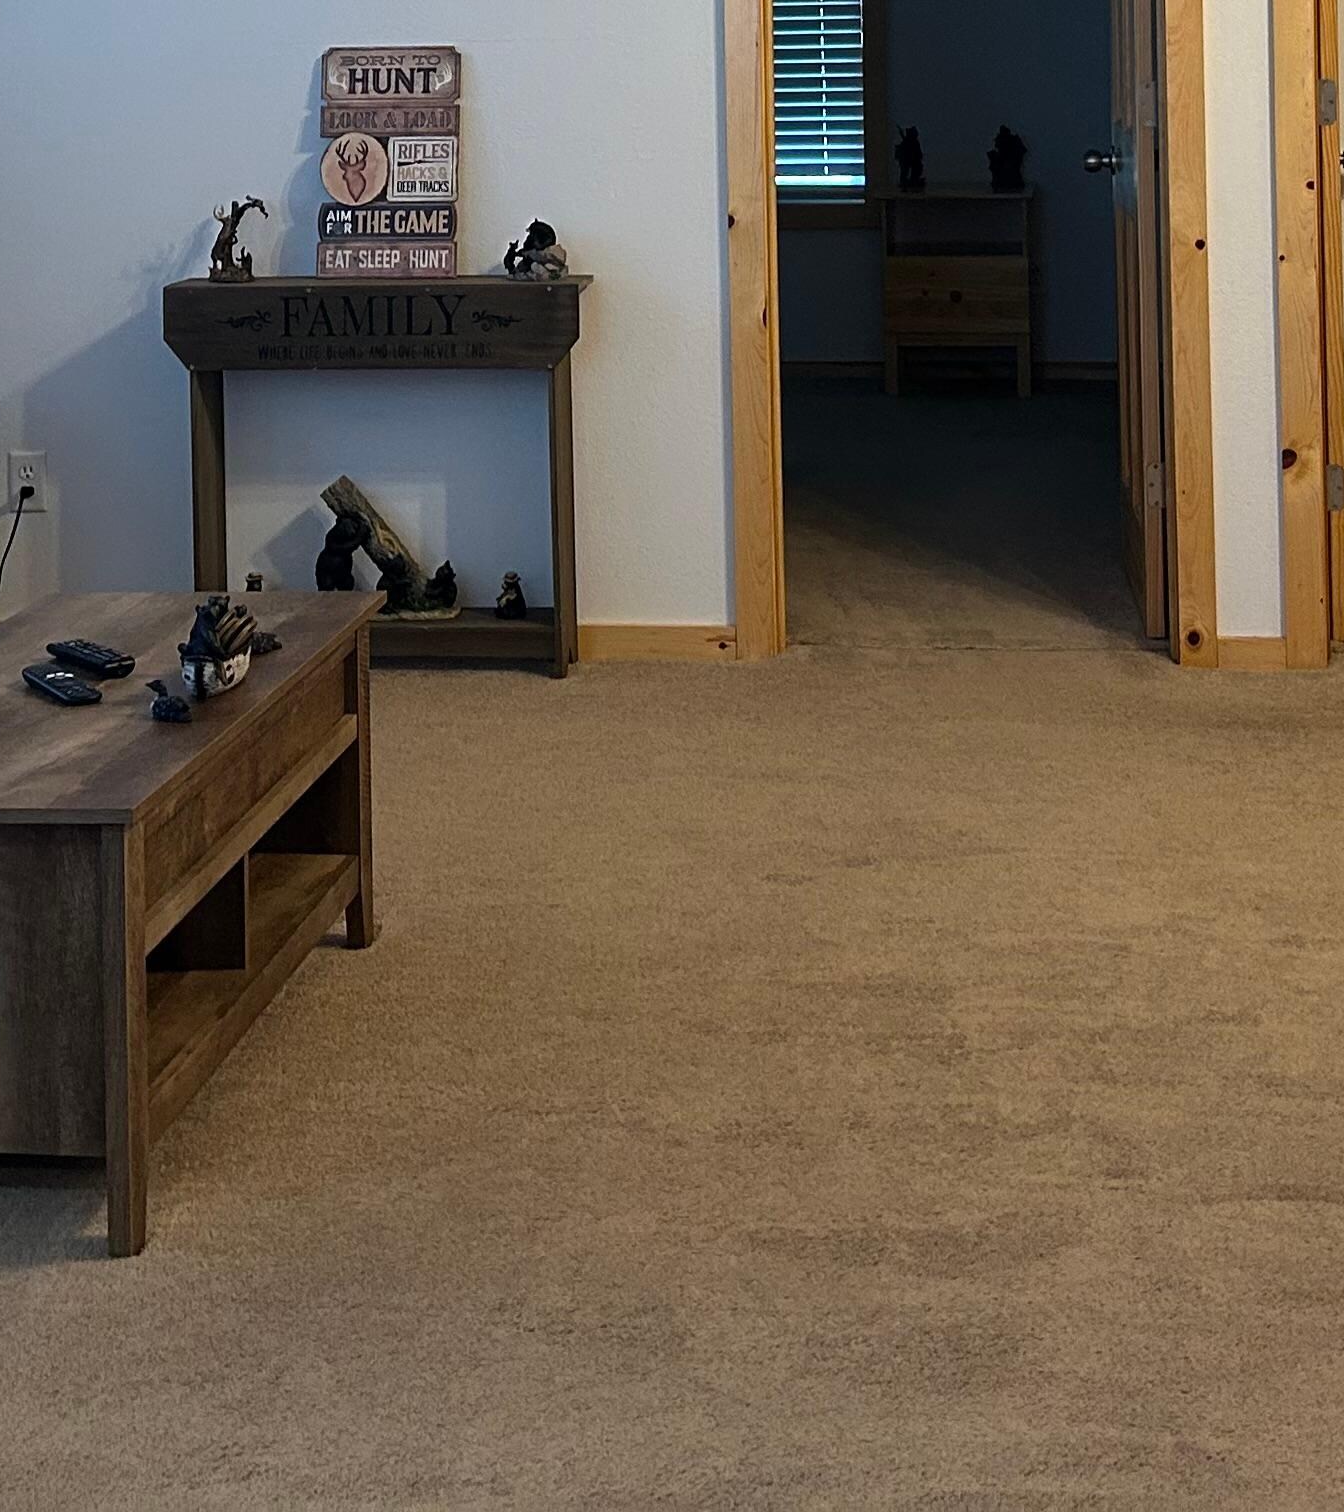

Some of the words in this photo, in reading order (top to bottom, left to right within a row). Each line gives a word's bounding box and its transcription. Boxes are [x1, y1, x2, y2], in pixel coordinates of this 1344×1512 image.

[339, 55, 405, 67] BORN
[412, 54, 441, 66] TO
[347, 67, 438, 95] HUNT
[328, 111, 378, 130] LOCK
[383, 111, 398, 129] &
[402, 110, 452, 129] LOAD
[398, 143, 450, 159] RIFLES
[418, 181, 450, 193] TRACKS
[326, 210, 352, 223] AIM
[354, 210, 391, 234] THE
[394, 210, 450, 234] GAME
[325, 249, 353, 269] EAT
[358, 249, 401, 269] SLEEP
[409, 249, 449, 269] HUNT
[280, 294, 468, 337] FAMILY
